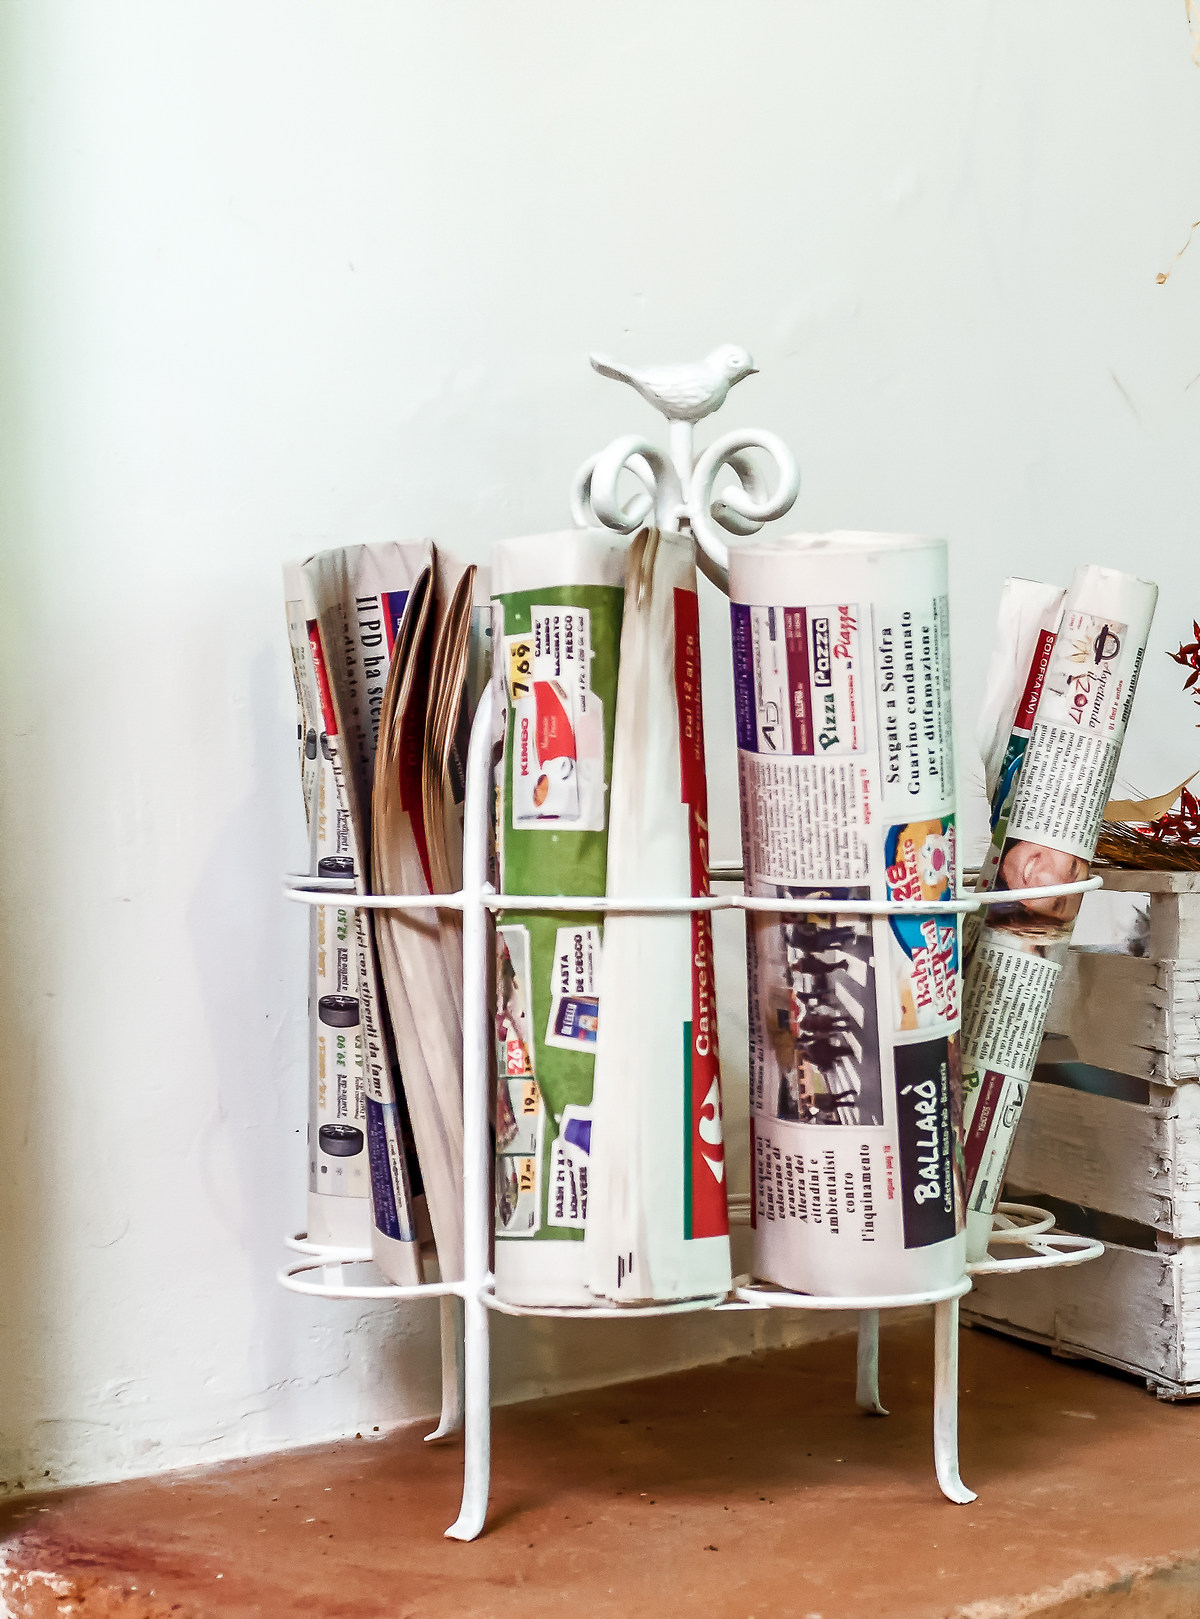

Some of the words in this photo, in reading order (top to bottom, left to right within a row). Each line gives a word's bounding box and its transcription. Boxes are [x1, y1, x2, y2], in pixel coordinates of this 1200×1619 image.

[355, 596, 378, 612] Il
[358, 620, 383, 647] PD
[565, 616, 574, 660] FRESCO
[833, 605, 858, 660] Piazza
[363, 656, 385, 679] ha
[684, 660, 694, 678] al
[814, 618, 830, 685] Pazza
[879, 627, 895, 692] Solofra
[901, 611, 916, 714] condannato
[1032, 634, 1054, 690] SOLOFRA
[919, 625, 935, 740] diffamazione
[885, 699, 896, 708] a
[1024, 690, 1039, 715] (AV)
[1066, 677, 1092, 725] 2017
[684, 708, 694, 739] Dal
[818, 693, 840, 750] Pizza
[521, 718, 529, 776] KIMBO
[884, 716, 901, 784] Sexgate
[905, 721, 921, 795] Guarino
[927, 747, 939, 776] per
[1063, 731, 1077, 757] portata
[1068, 752, 1081, 771] dopo
[1068, 781, 1082, 810] Vergine
[1051, 828, 1059, 838] ha
[359, 952, 367, 976] con
[574, 934, 583, 974] CECCO
[340, 964, 350, 985] partire
[560, 954, 569, 993] PASTA
[575, 978, 584, 993] DE
[910, 947, 933, 1009] Baby
[935, 926, 959, 1021] Party
[362, 982, 379, 1037] stipendi
[991, 1007, 999, 1016] la
[369, 1042, 379, 1058] da
[978, 1040, 990, 1061] della
[1004, 1024, 1020, 1057] Pasquale
[340, 1080, 347, 1088] da
[371, 1064, 384, 1097] fame
[339, 1090, 350, 1111] partire
[772, 1147, 780, 1160] di
[900, 1079, 941, 1205] BALLARÒ
[757, 1160, 767, 1196] acque
[774, 1164, 785, 1219] colorano
[784, 1155, 796, 1218] arancione
[822, 1150, 839, 1235] ambientalisti
[843, 1172, 855, 1213] contro
[859, 1144, 877, 1242] l'inquinamento
[555, 1186, 564, 1218] DASH
[766, 1185, 775, 1221] fiume
[797, 1179, 808, 1224] Allerta
[808, 1169, 822, 1224] cittadini
